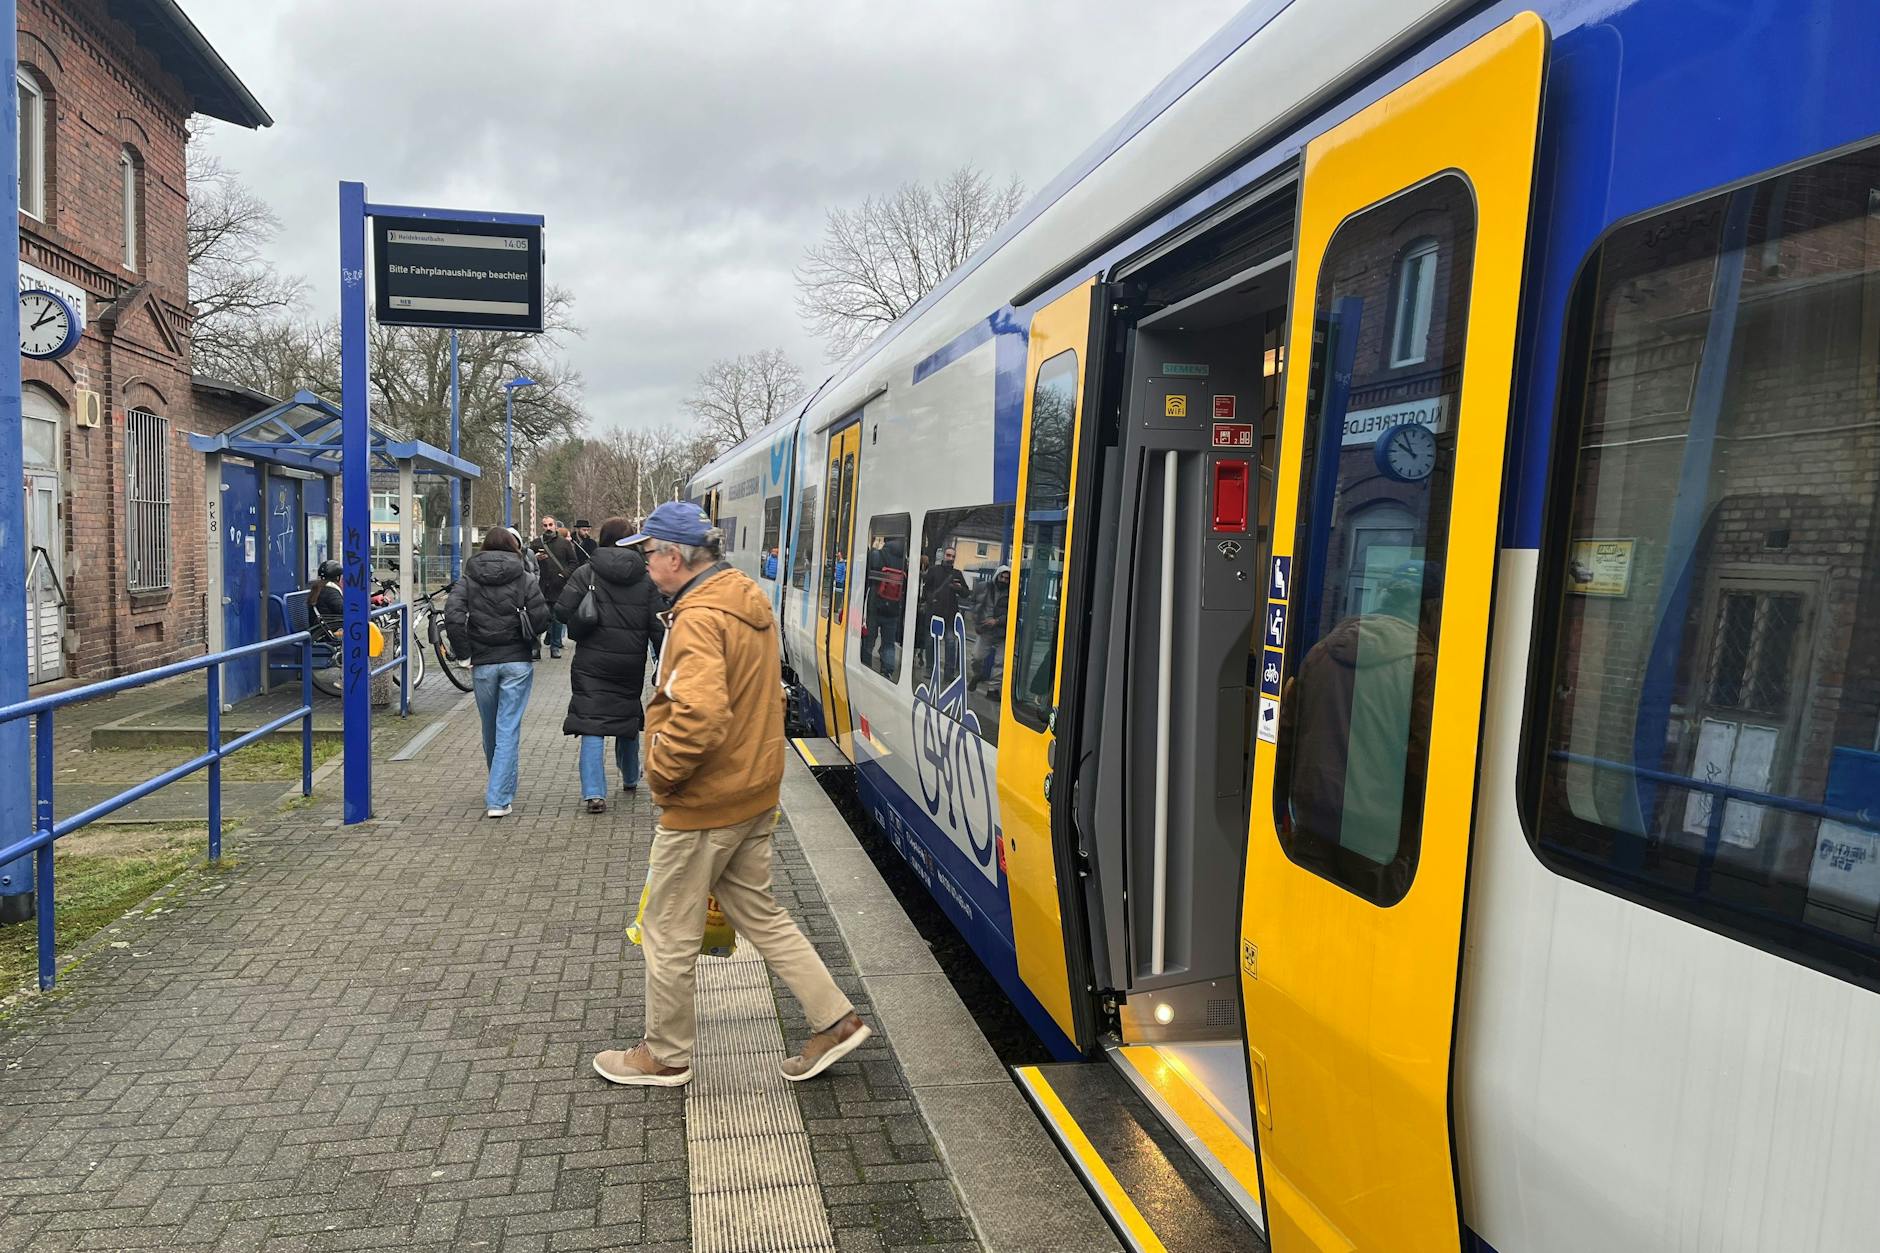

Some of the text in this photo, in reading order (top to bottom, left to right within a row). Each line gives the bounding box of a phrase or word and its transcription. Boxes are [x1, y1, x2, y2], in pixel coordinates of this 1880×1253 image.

[504, 240, 527, 249] 14:05
[389, 264, 528, 280] Bitte Fahrplanaushänge beachten!
